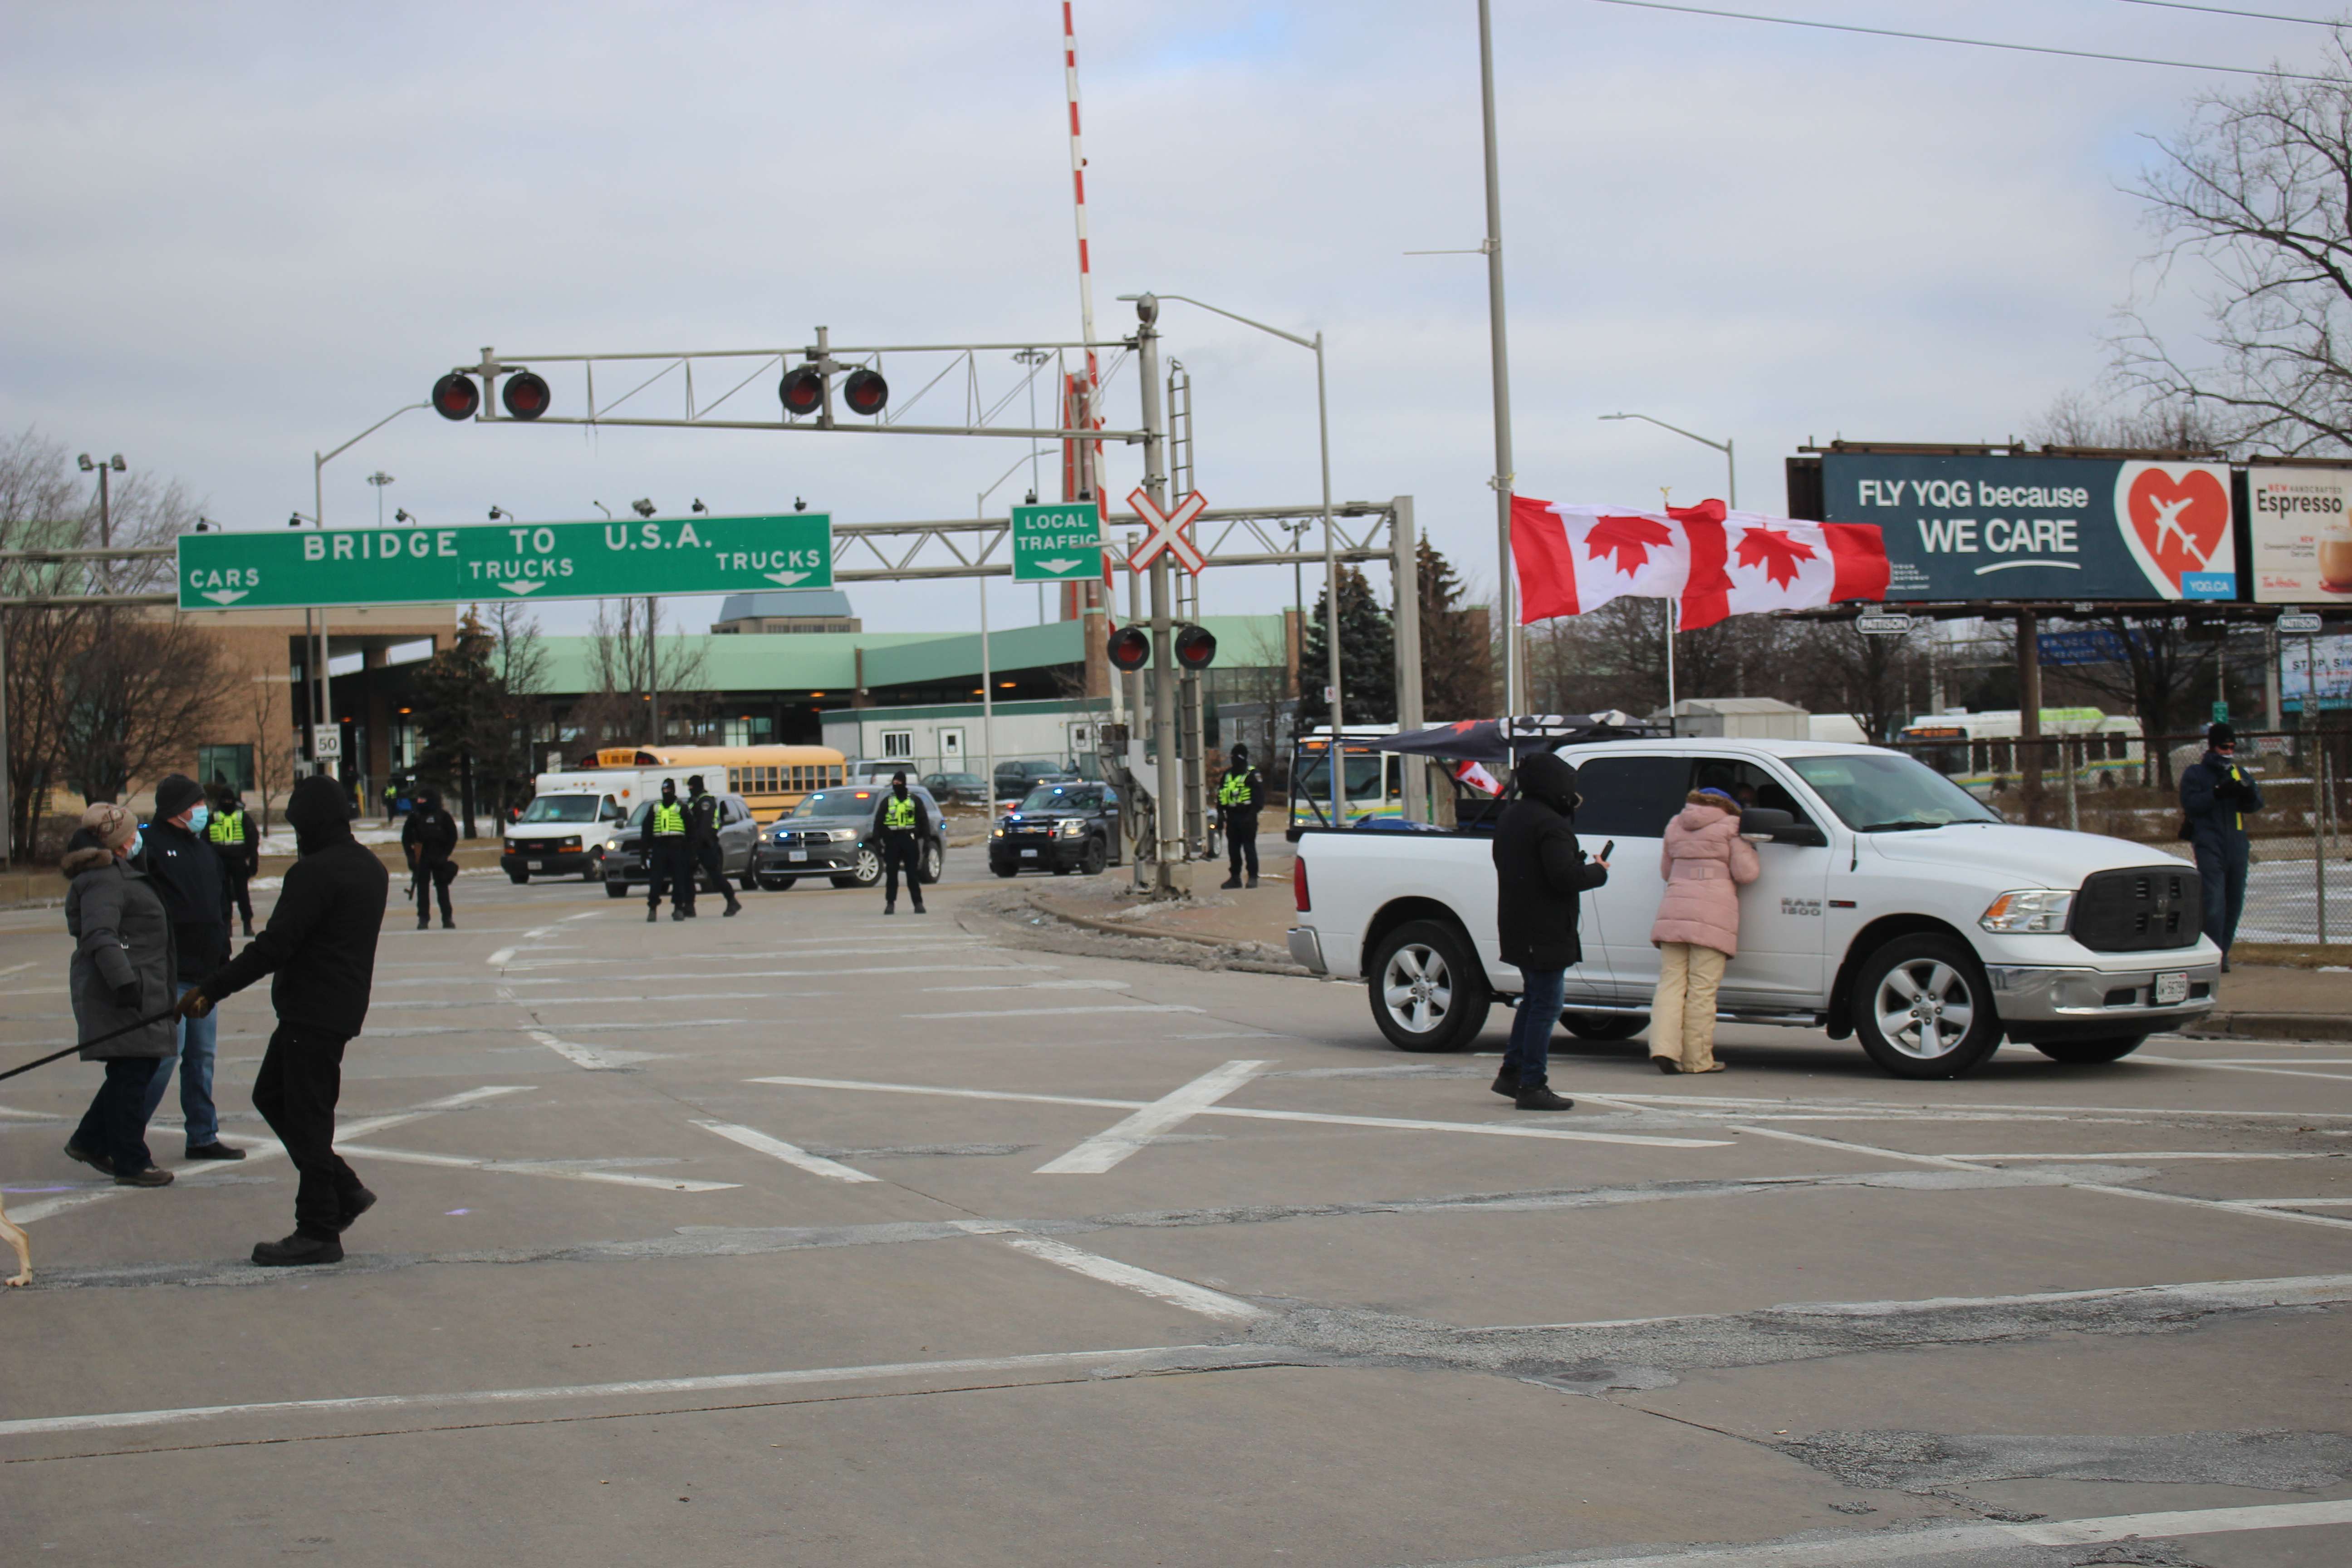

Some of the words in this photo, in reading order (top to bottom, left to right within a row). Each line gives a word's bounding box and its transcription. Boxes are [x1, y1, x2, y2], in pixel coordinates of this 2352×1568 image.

[1858, 480, 1906, 507] FLY
[1911, 480, 1972, 509] YQG
[1978, 480, 2088, 508] because
[2268, 484, 2287, 492] NEW
[2257, 489, 2342, 519] Espresso
[1025, 514, 1088, 529] LOCAL
[304, 532, 457, 561] BRIDGE
[509, 527, 554, 554] TO
[605, 523, 712, 551] U.S.A.
[1017, 533, 1099, 551] TRAFFIC
[1917, 519, 1978, 553] WE
[1985, 518, 2078, 553] CARE
[469, 558, 573, 579] TRUCKS
[716, 549, 820, 570] TRUCKS
[190, 568, 259, 588] CARS
[319, 736, 337, 751] 50
